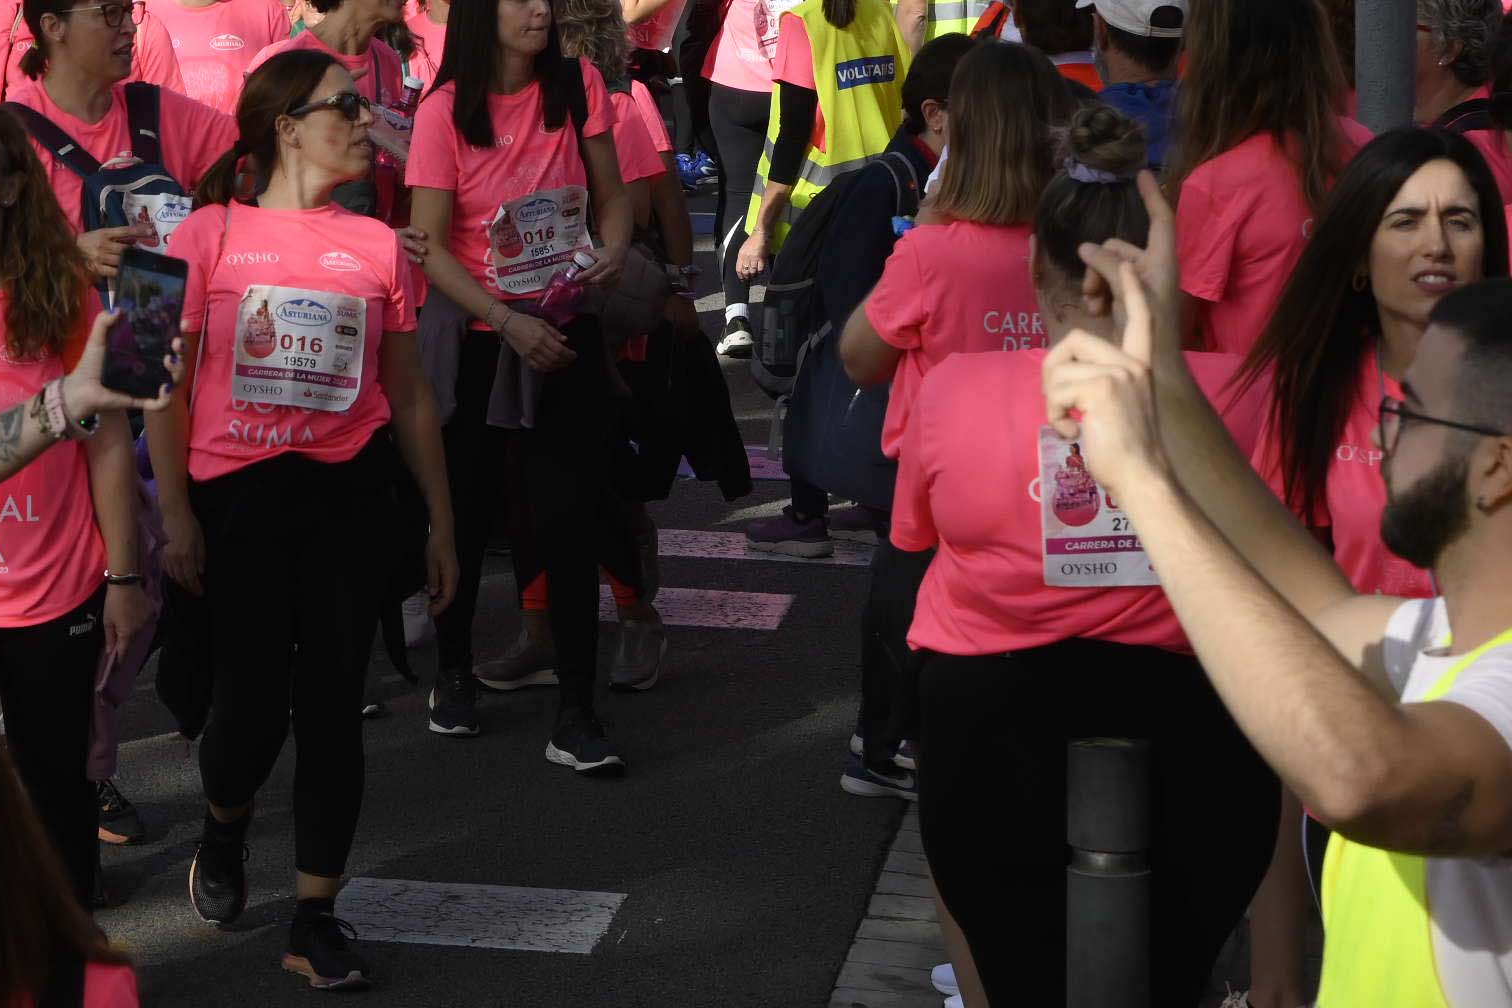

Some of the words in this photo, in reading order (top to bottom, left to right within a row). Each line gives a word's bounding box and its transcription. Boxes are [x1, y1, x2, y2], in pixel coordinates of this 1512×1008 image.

[523, 226, 555, 244] 016
[226, 252, 280, 265] OYSHO
[508, 276, 541, 289] OYSHO
[279, 307, 328, 322] ASTURIANA
[280, 334, 324, 353] 016
[284, 356, 317, 369] 19579
[243, 384, 283, 396] OYSHO
[313, 390, 349, 402] Santander
[1065, 540, 1114, 551] CARRERA
[1118, 539, 1133, 549] DE
[1061, 562, 1118, 576] OYSHO
